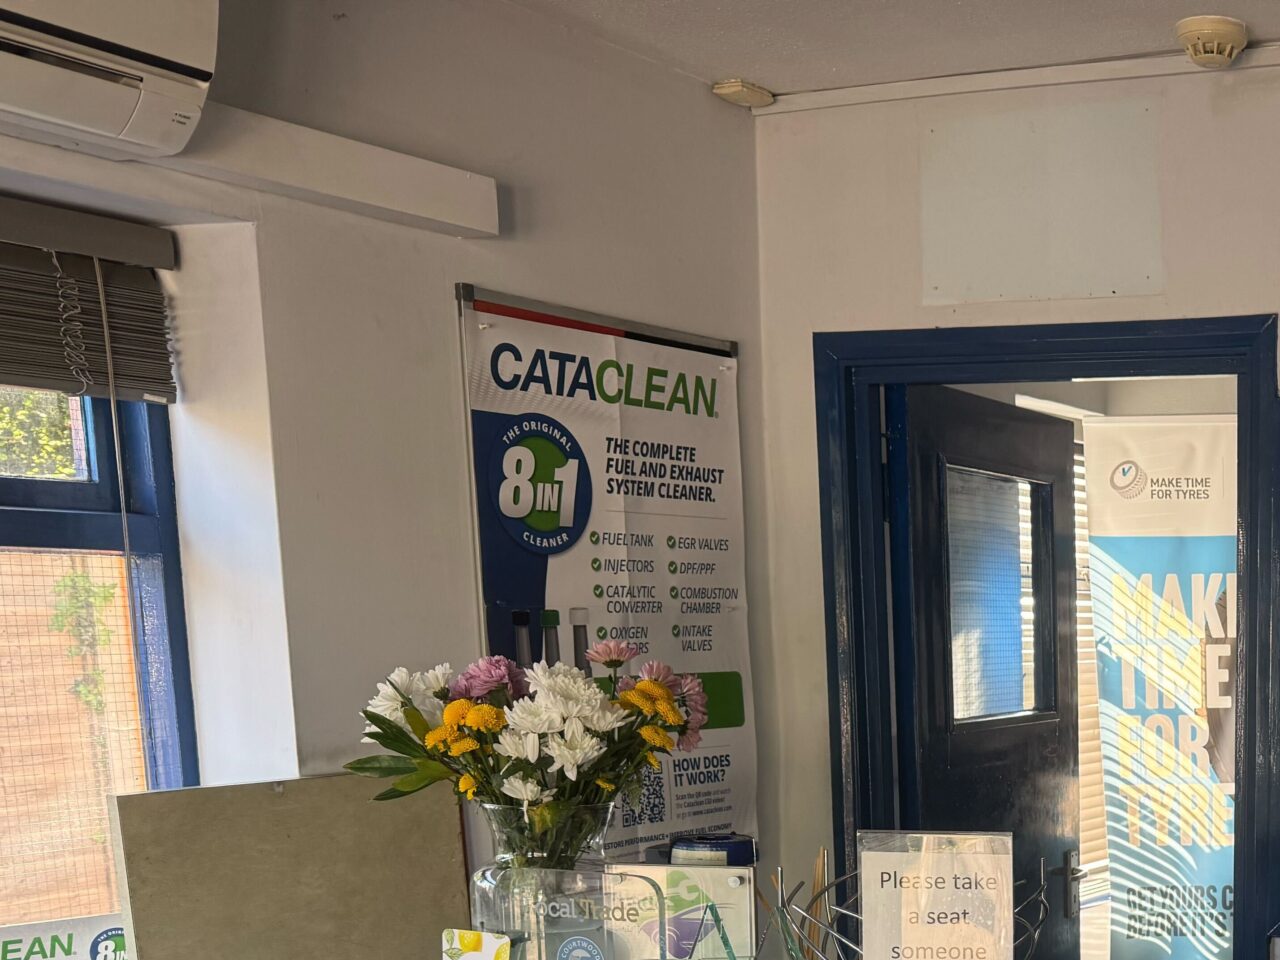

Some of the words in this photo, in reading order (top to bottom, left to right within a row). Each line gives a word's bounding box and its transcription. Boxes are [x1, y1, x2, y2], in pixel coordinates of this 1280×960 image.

[502, 424, 521, 445] THE
[522, 420, 573, 452] ORIGINAL
[605, 437, 630, 456] THE
[632, 440, 697, 463] COMPLETE
[605, 457, 636, 476] FUEL
[638, 461, 667, 479] AND
[669, 465, 724, 485] EXHAUST
[498, 445, 535, 519] 8
[535, 482, 560, 512] IN
[554, 458, 579, 528] 1
[606, 478, 655, 498] SYSTEM
[657, 483, 716, 503] CLEANER.
[1150, 477, 1182, 488] MAKE
[1184, 477, 1211, 488] TIME
[1150, 489, 1173, 500] FOR
[1174, 489, 1210, 500] TYRES
[523, 531, 570, 548] CLEANER
[602, 532, 628, 546] FUEL
[629, 533, 654, 547] TANK
[678, 537, 696, 549] EGR
[698, 538, 729, 551] VALVES
[603, 558, 655, 575] INJECTORS
[679, 562, 716, 575] DPF/PPF
[606, 585, 656, 598] CATALYTIC
[680, 587, 738, 600] COMBUSTION
[606, 601, 663, 614] CONVERTER
[680, 602, 721, 614] CHAMBER
[609, 626, 648, 640] OXYGEN
[681, 625, 713, 637] INTAKE
[681, 639, 713, 652] VALVES
[1112, 643, 1232, 709] TIME
[1117, 713, 1210, 780] FOR
[673, 757, 701, 773] HOW
[703, 754, 731, 769] DOES
[674, 773, 684, 788] IT
[686, 769, 726, 786] WORK?
[1118, 783, 1235, 848] TYRE
[880, 870, 946, 890] Please
[952, 872, 998, 890] take
[1126, 886, 1157, 912] GET
[1160, 884, 1218, 911] YOURS
[580, 899, 640, 923] Trade
[909, 911, 919, 925] a
[926, 908, 970, 925] seat
[1126, 912, 1187, 939] BEFORE
[561, 940, 601, 960] COURTWOOD
[891, 945, 987, 960] someone
